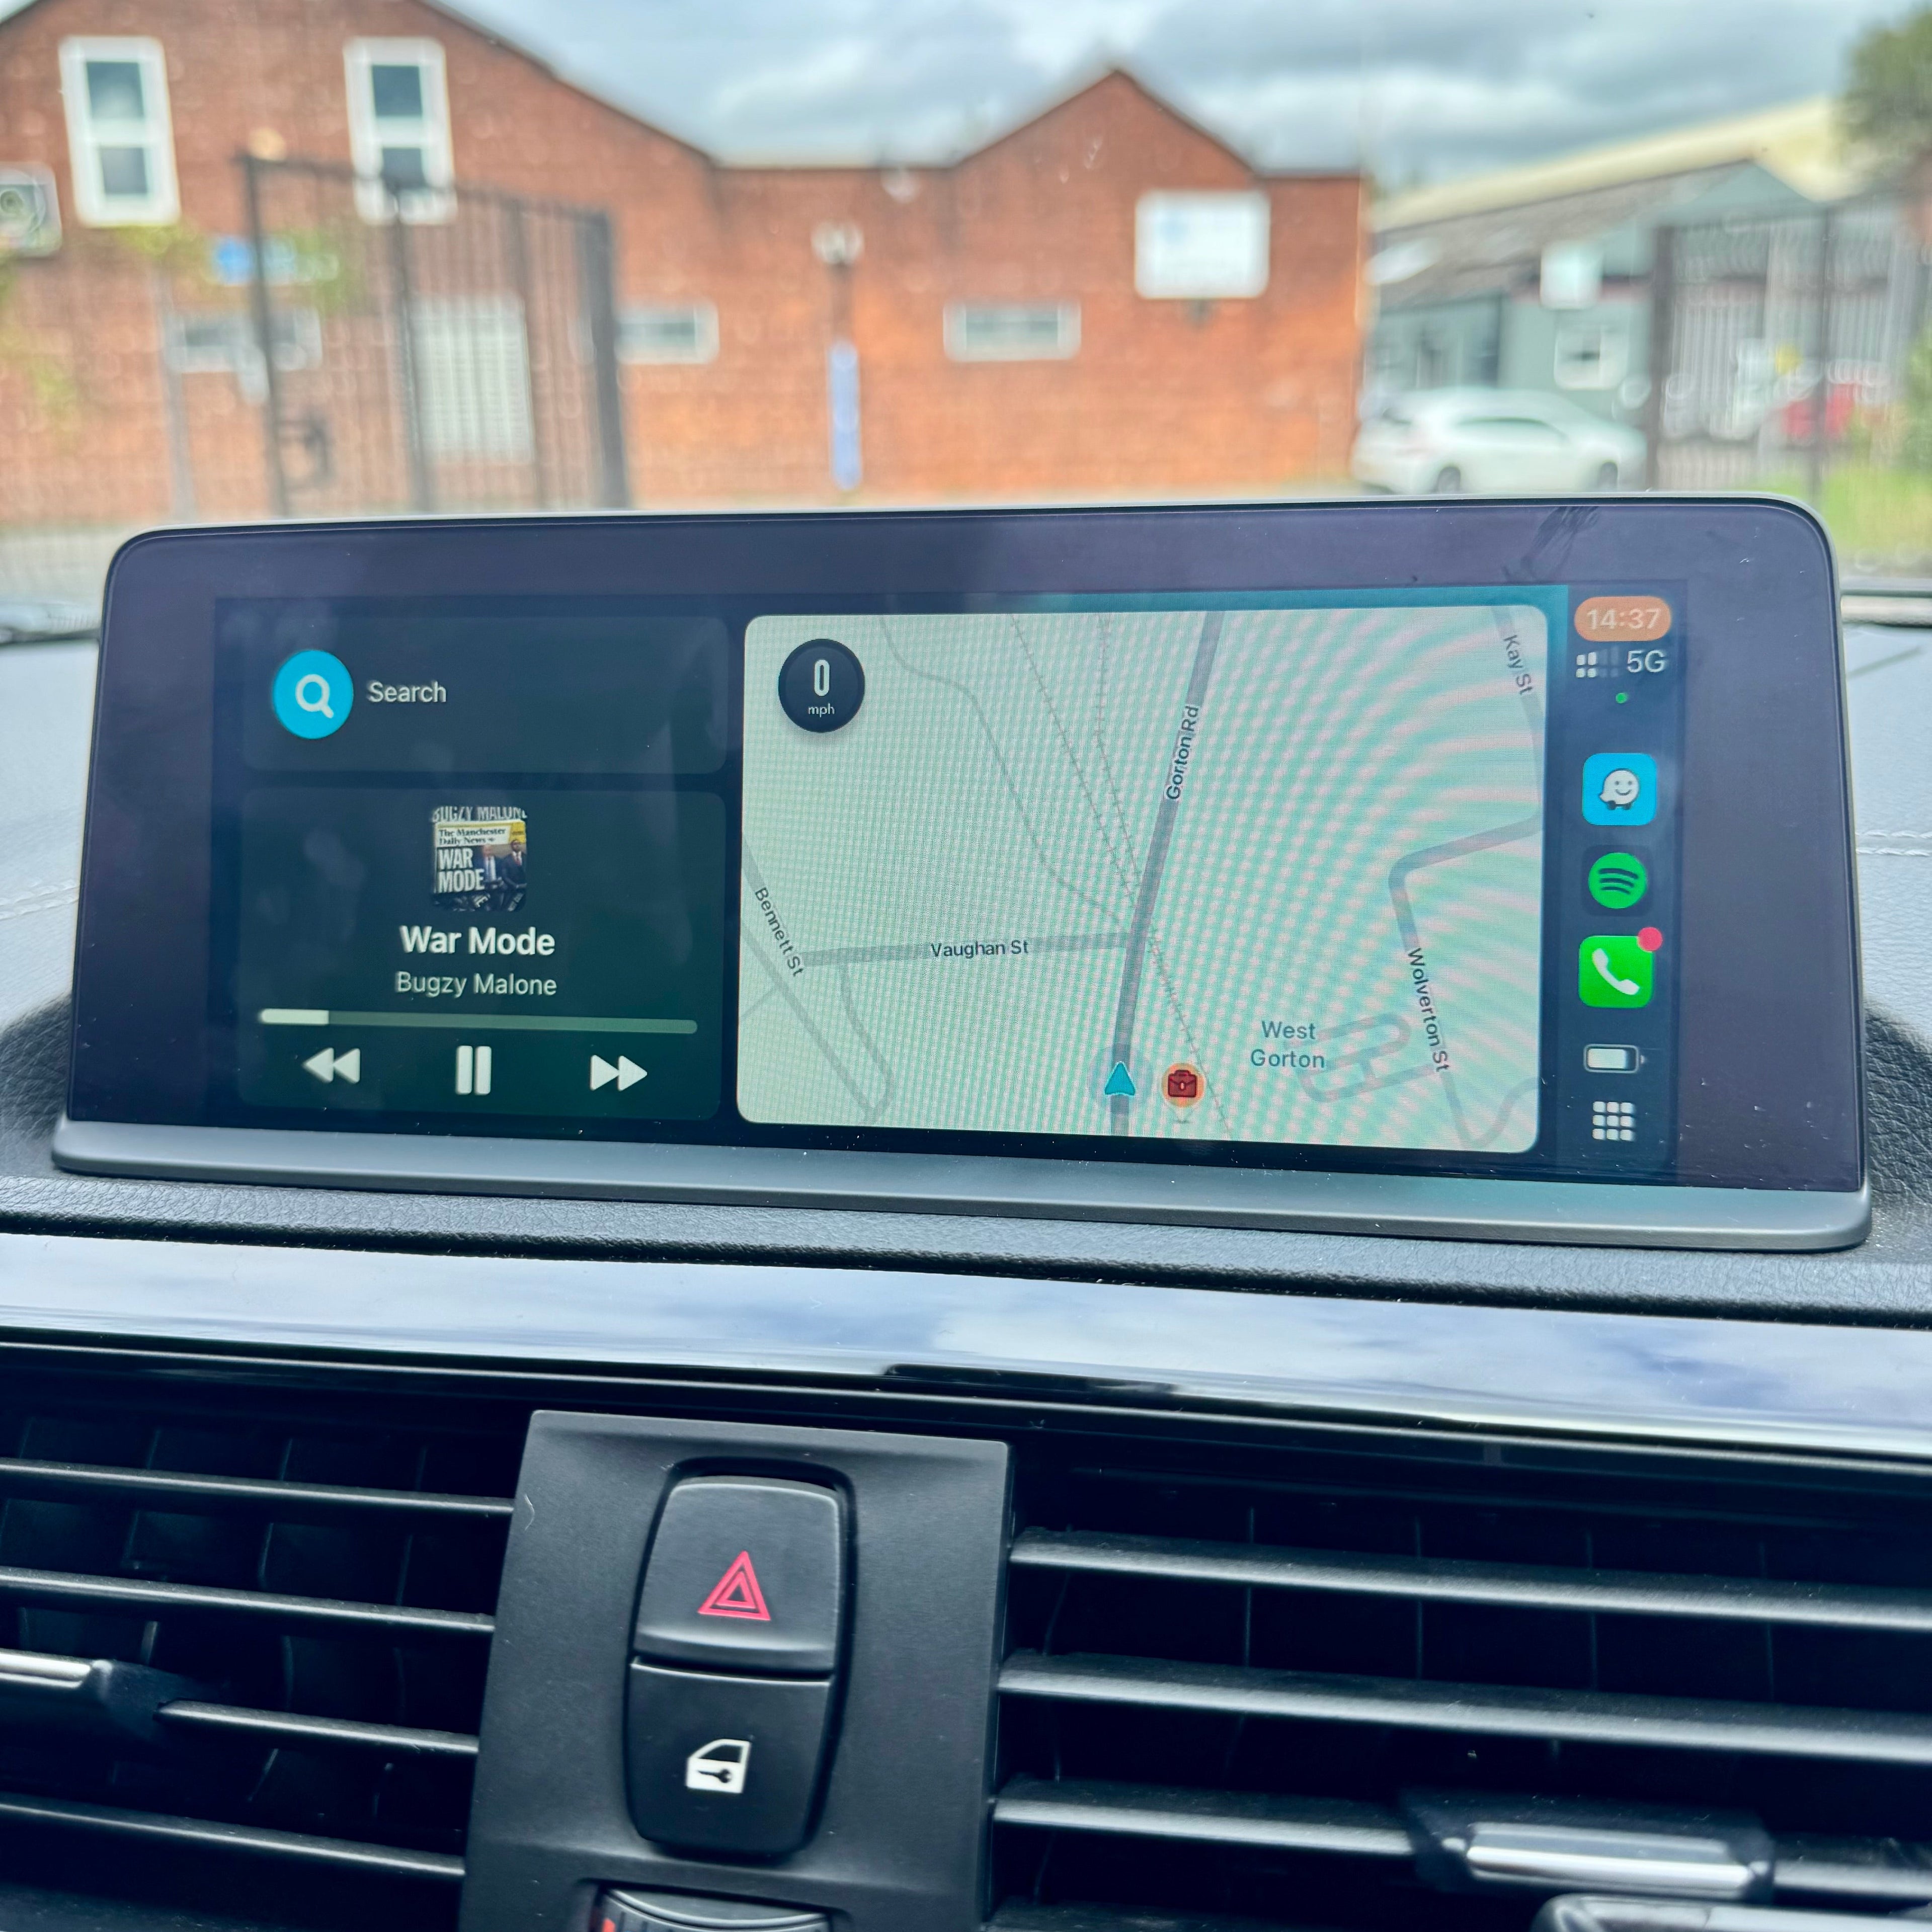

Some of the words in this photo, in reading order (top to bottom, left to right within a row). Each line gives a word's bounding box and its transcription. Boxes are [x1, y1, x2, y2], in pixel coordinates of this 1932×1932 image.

[1586, 608, 1662, 629] 14:37
[1503, 635, 1523, 669] Kay
[1516, 674, 1533, 695] St
[1627, 650, 1667, 673] 5G
[814, 659, 830, 696] 0
[367, 680, 447, 703] Search
[808, 703, 835, 718] mph
[1166, 736, 1192, 800] Gorton
[1181, 705, 1199, 732] Rd
[432, 806, 473, 823] BUGZY
[439, 837, 461, 846] Daily
[456, 828, 506, 836] Manchester
[438, 847, 473, 870] WAR
[438, 868, 485, 894] MODE
[399, 925, 462, 954] War
[468, 926, 555, 955] Mode
[755, 887, 793, 955] Bennett
[787, 956, 804, 977] St
[931, 940, 1006, 959] Vaughan
[1010, 939, 1028, 954] St
[395, 971, 467, 998] Bugzy
[473, 973, 557, 996] Malone
[1408, 947, 1440, 1047] Wolverton
[1432, 1051, 1450, 1073] St
[1261, 1020, 1316, 1040] West
[1251, 1048, 1325, 1068] Gorton
